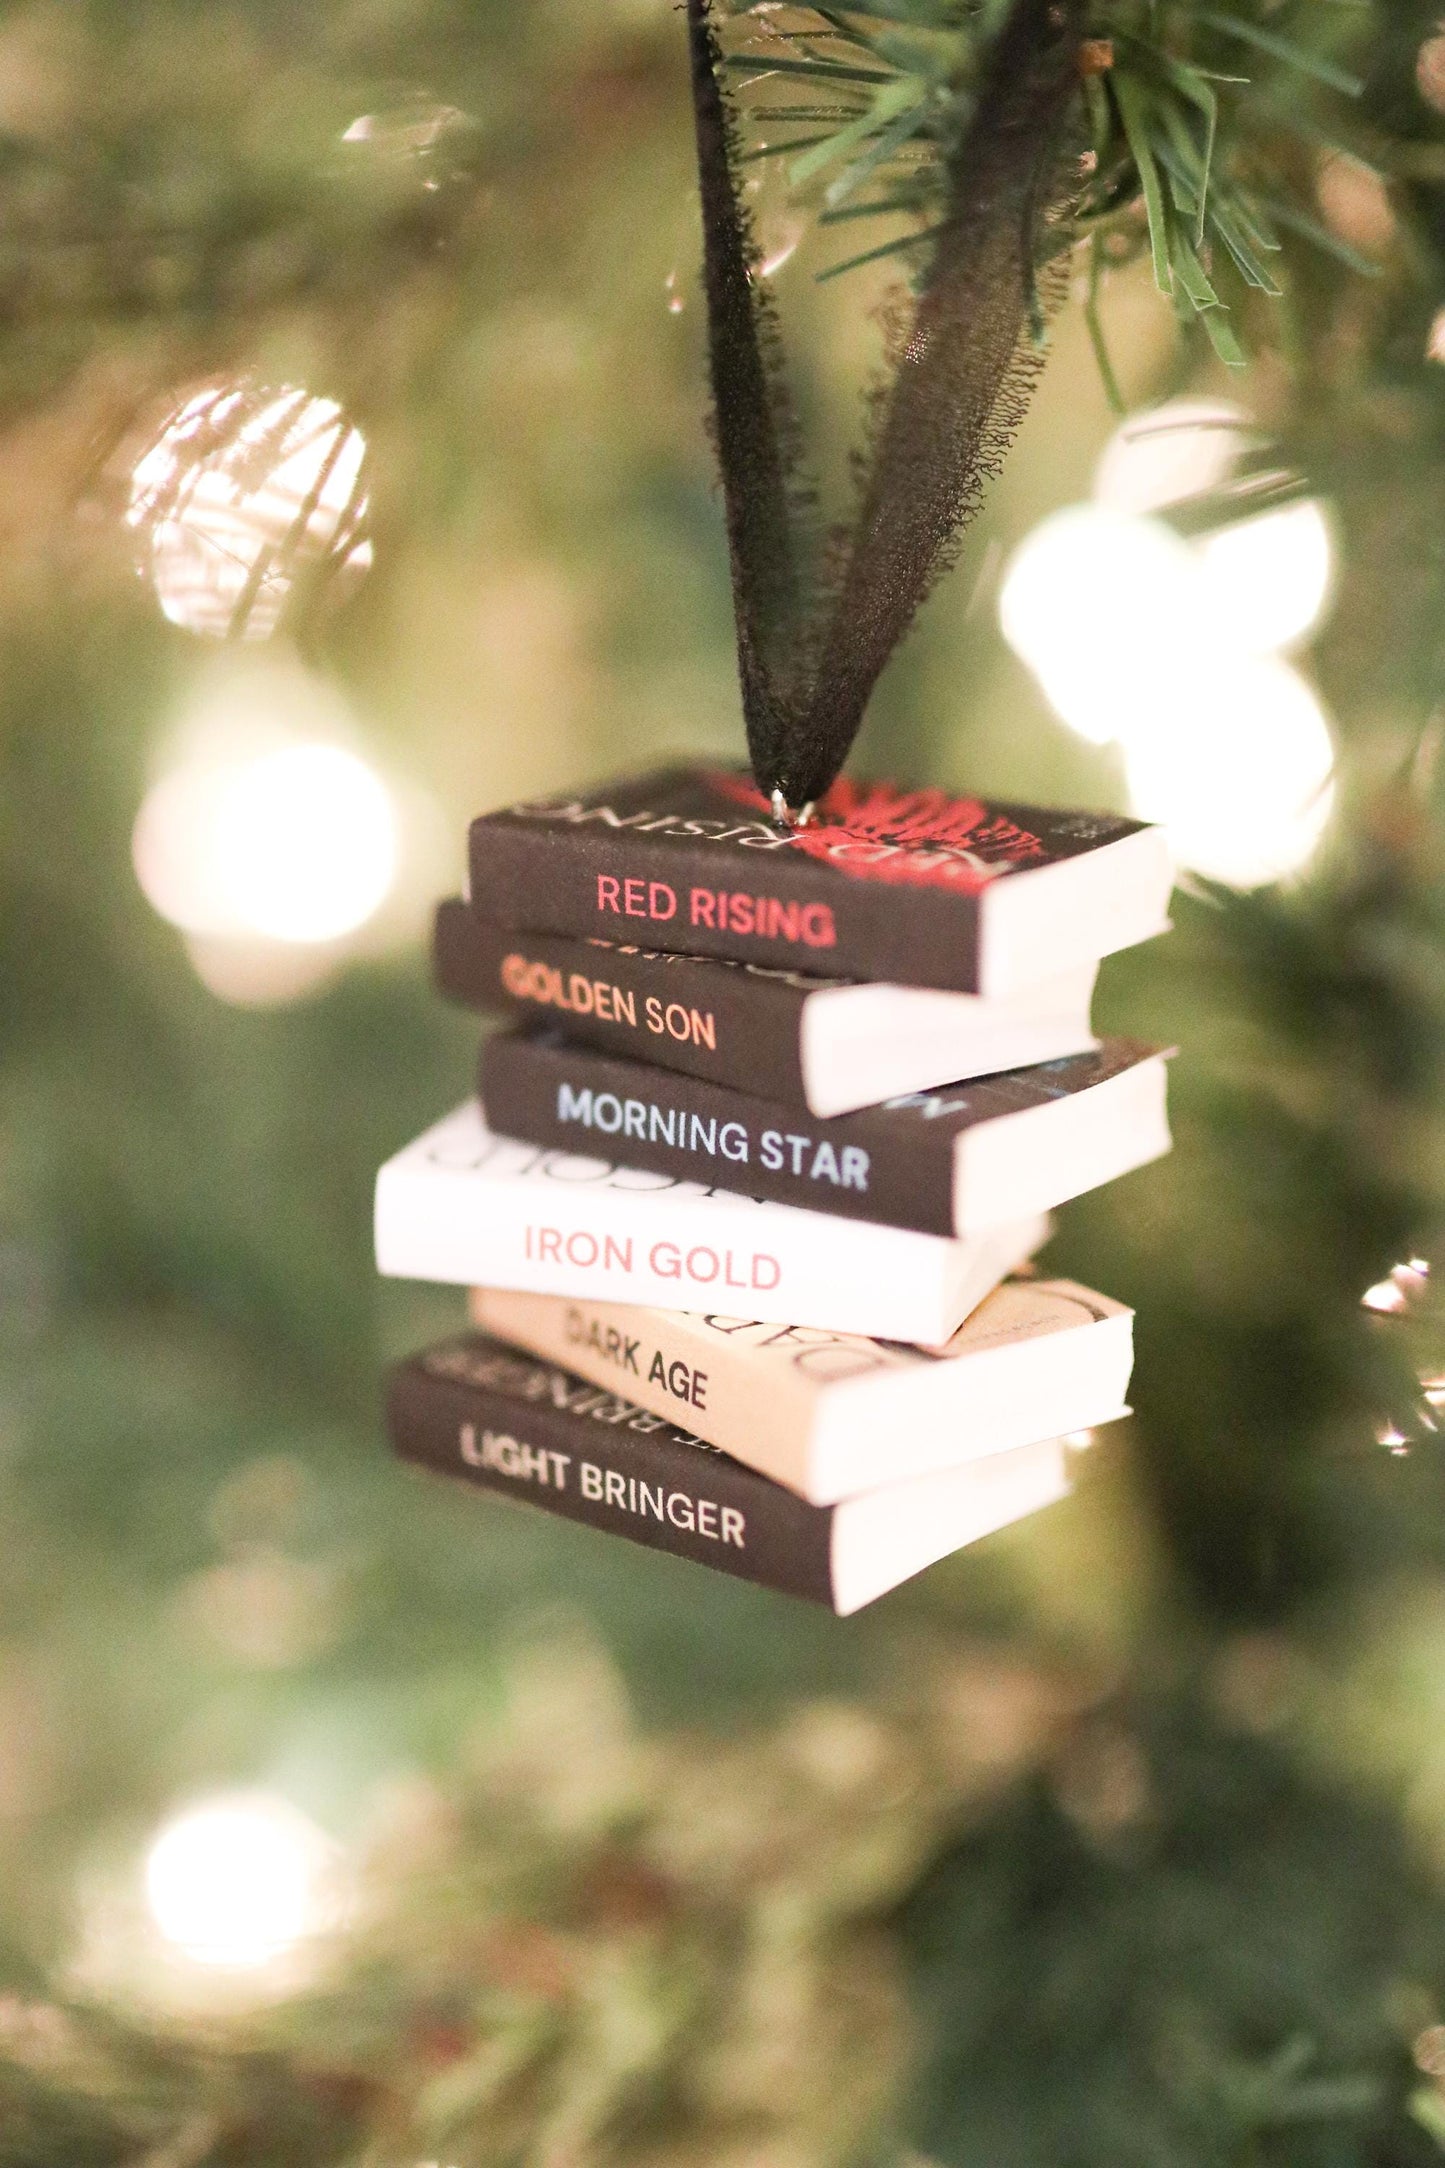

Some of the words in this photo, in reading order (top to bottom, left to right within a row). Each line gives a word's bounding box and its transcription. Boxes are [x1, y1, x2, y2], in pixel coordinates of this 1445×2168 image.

[596, 874, 677, 924] RED
[690, 888, 837, 949] RISING
[500, 952, 635, 1028] GOLDEN
[646, 998, 717, 1051] SON
[556, 1082, 748, 1163] MORNING
[760, 1130, 870, 1193] STAR
[524, 1224, 633, 1273] IRON
[648, 1245, 782, 1291] GOLD
[563, 1306, 640, 1375] DARK
[648, 1350, 709, 1411] AGE
[458, 1421, 570, 1491] LIGHT
[580, 1461, 746, 1549] BRINGER
